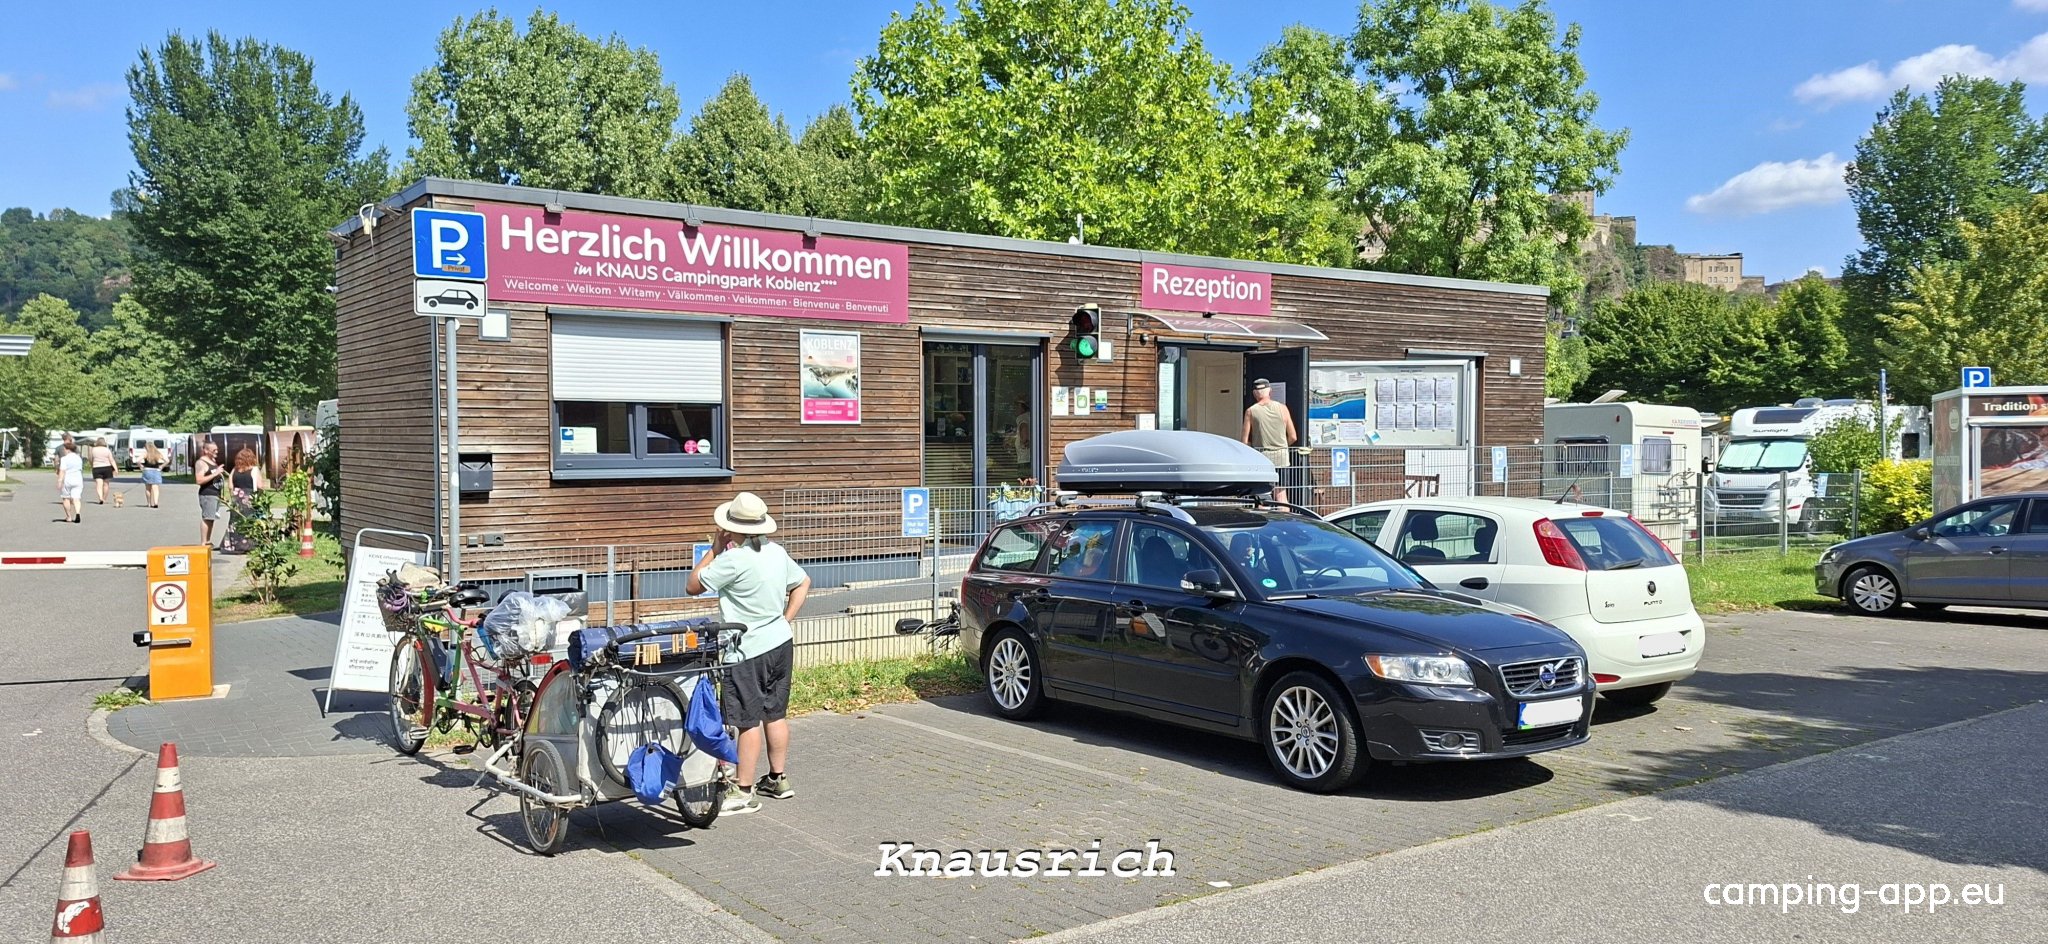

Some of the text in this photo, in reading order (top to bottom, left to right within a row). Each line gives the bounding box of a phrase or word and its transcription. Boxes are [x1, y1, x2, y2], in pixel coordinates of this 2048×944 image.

[430, 218, 469, 269] P
[501, 214, 892, 281] Herzlich Willkommen
[573, 261, 592, 277] im
[596, 261, 658, 281] KNAUS
[662, 266, 762, 290] Campingpark
[1153, 267, 1263, 303] Rezeption
[504, 278, 889, 313] Welcome Welkom Witamy Välkommen Velkommen Bienvenue Benvenuti
[805, 337, 853, 351] KOBLENZ
[1968, 370, 1984, 388] P
[1982, 401, 2037, 411] Tradition
[1336, 451, 1346, 468] P
[1496, 450, 1504, 465] P
[1623, 448, 1632, 461] P
[908, 493, 923, 514] P
